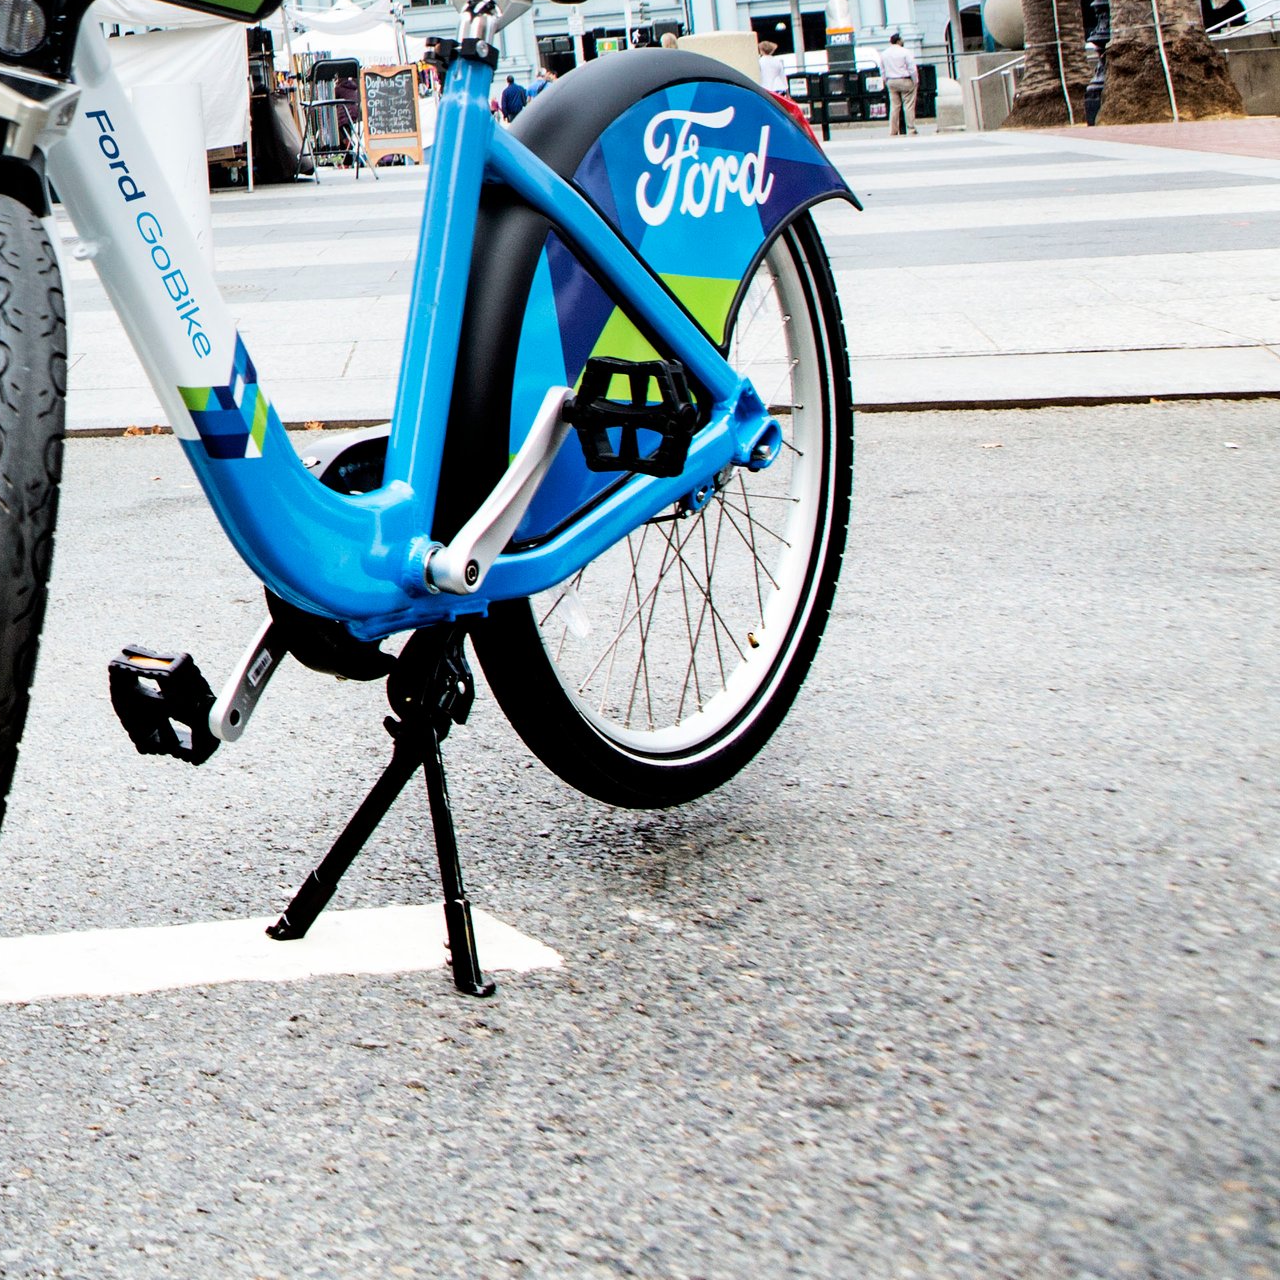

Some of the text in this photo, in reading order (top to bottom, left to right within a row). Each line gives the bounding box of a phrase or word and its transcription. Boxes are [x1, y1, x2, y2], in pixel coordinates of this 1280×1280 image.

[85, 108, 213, 360] Ford GoBike
[635, 105, 775, 227] Ford
